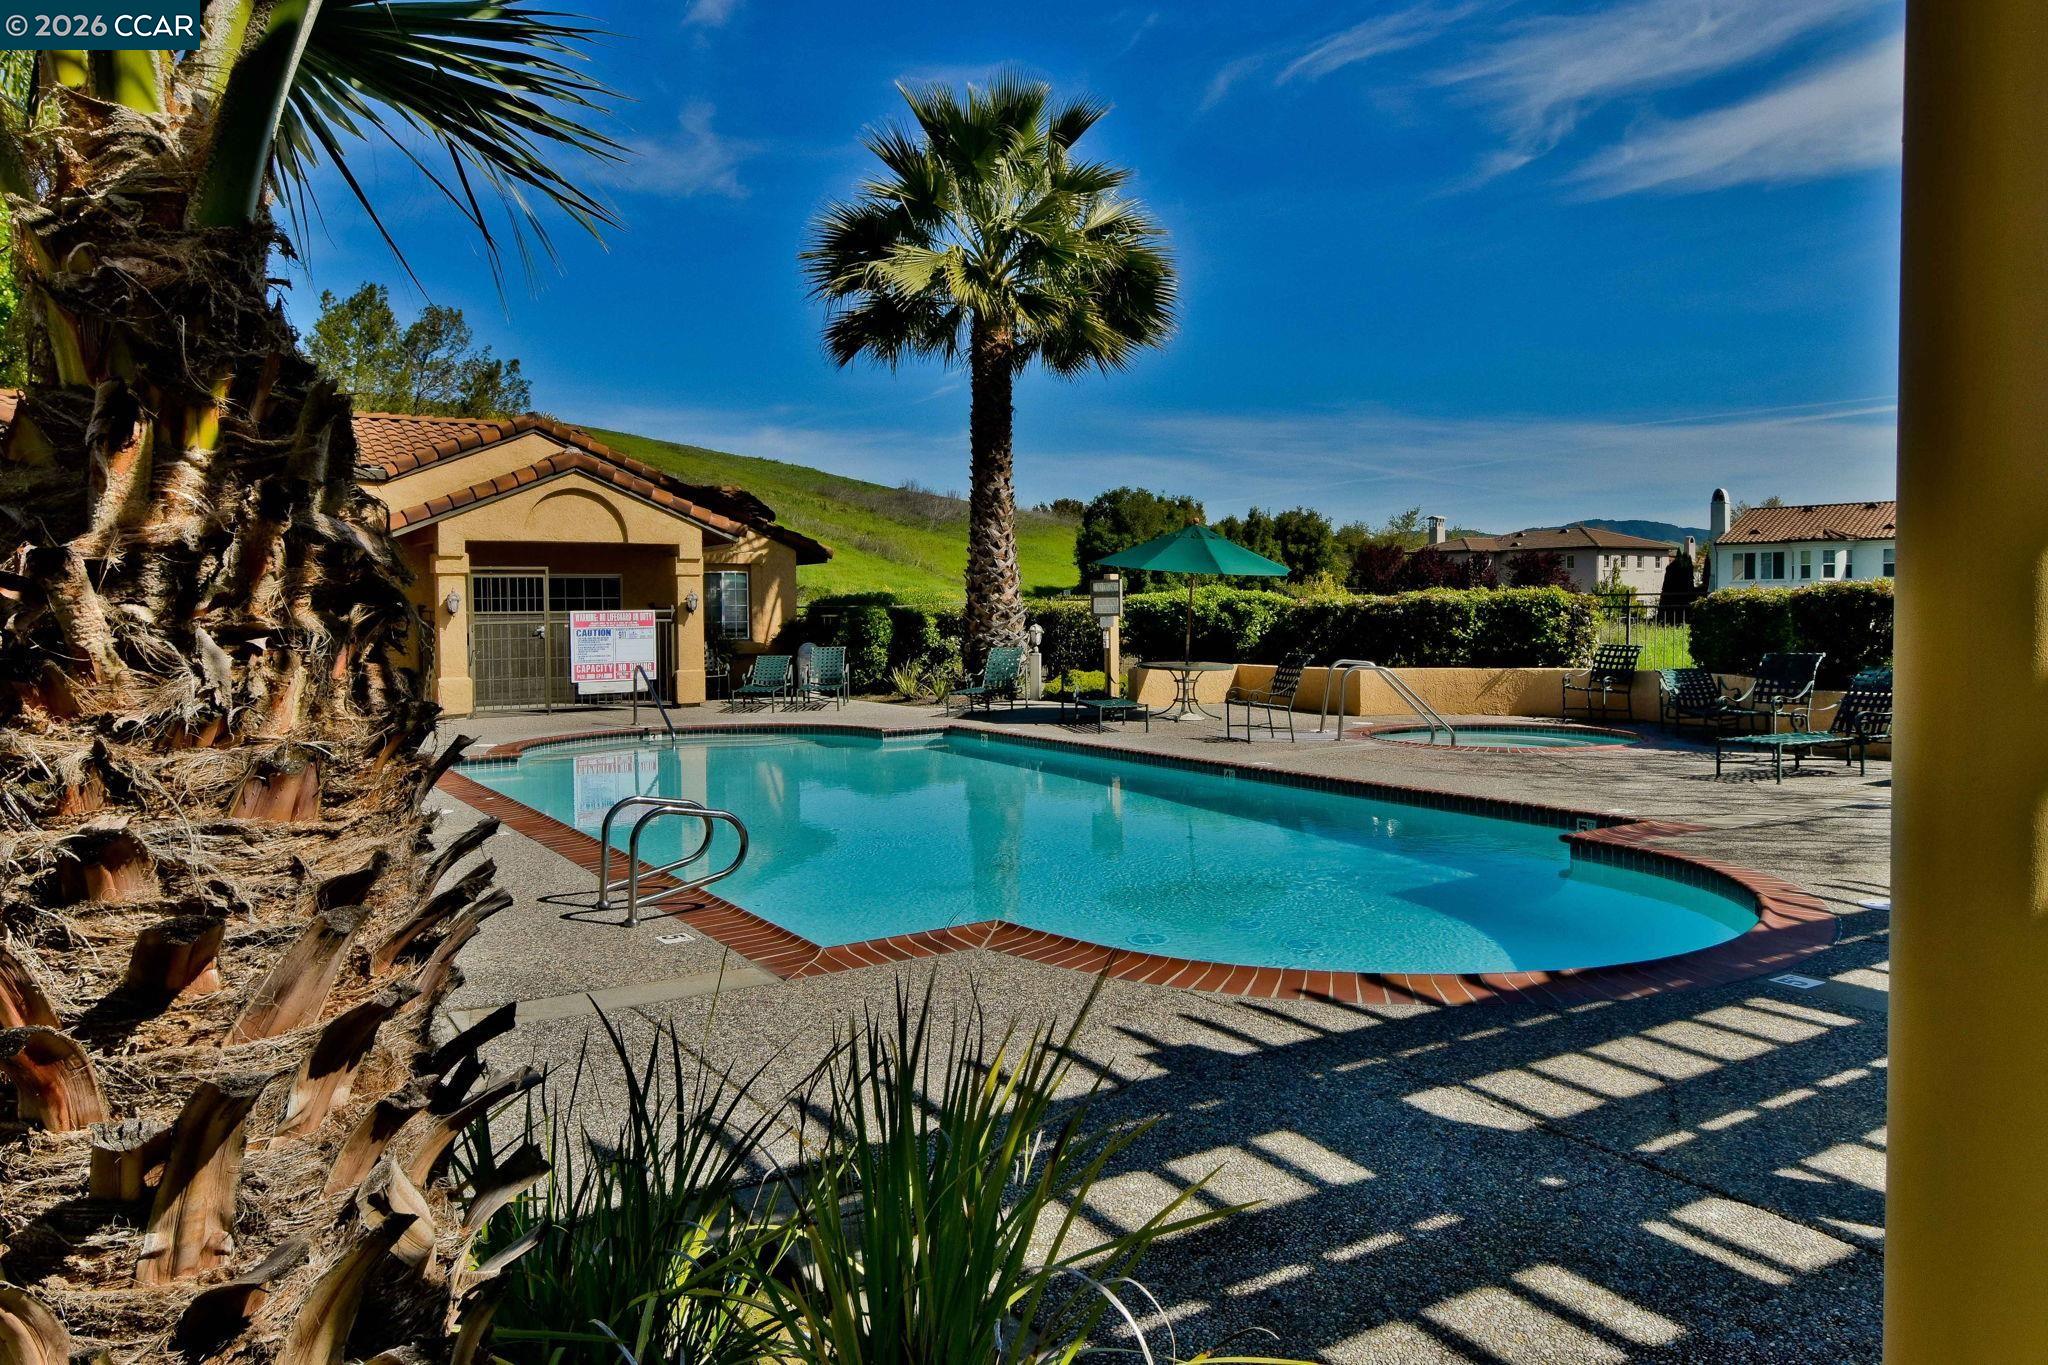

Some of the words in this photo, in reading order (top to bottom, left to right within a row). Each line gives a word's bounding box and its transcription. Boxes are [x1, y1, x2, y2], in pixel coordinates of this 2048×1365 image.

[576, 629, 612, 638] CAUTION
[576, 664, 613, 673] CAPACITY
[618, 663, 627, 671] NO
